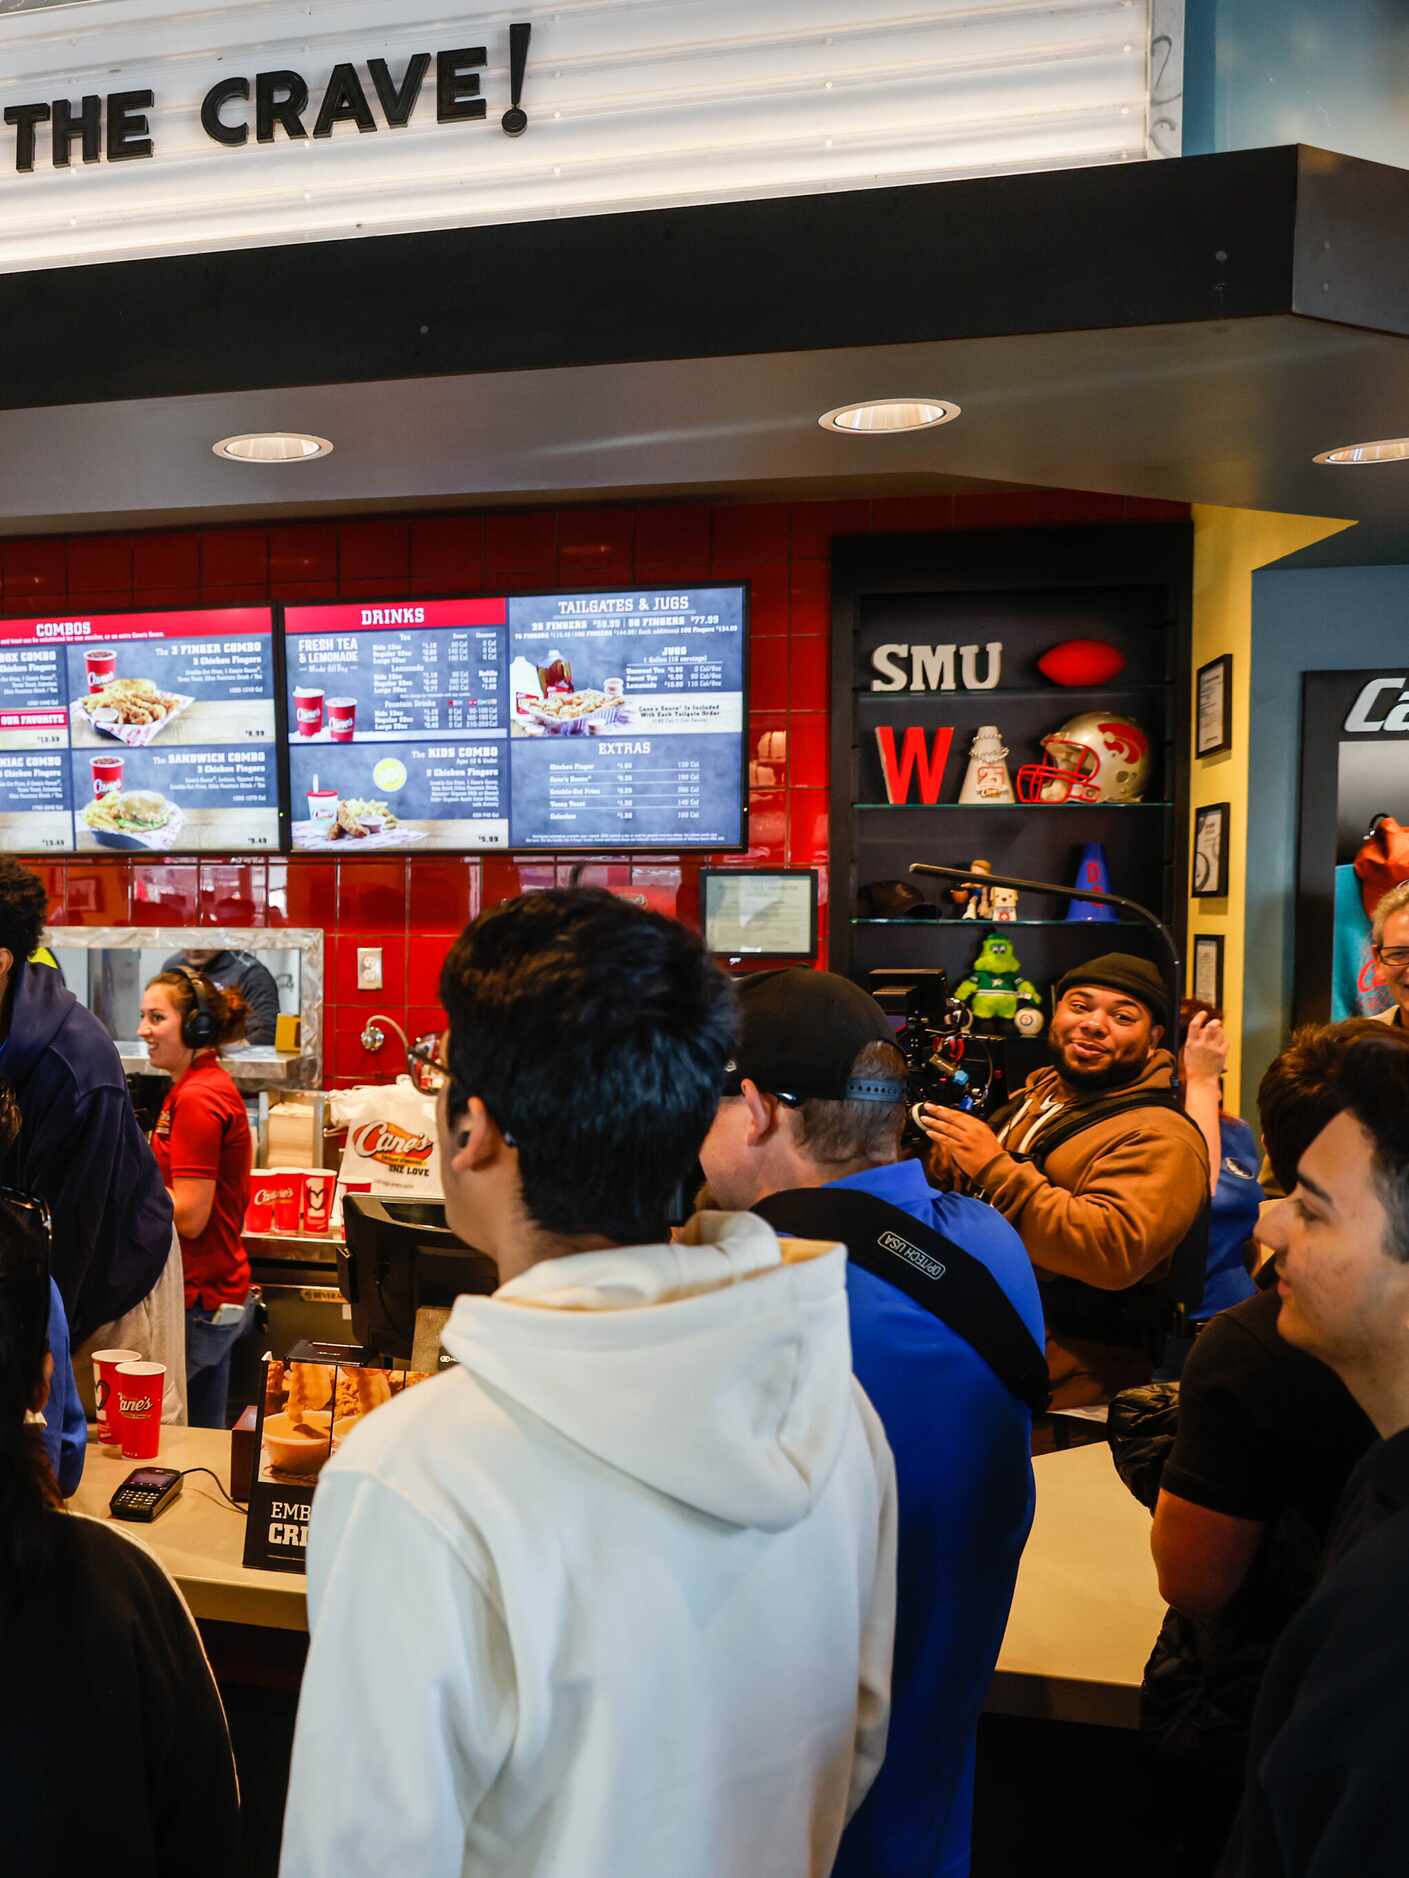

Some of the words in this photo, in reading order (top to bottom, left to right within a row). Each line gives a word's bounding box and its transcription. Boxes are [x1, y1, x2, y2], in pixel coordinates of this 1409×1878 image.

[3, 89, 154, 174] THE
[200, 22, 532, 147] CRAVE!
[558, 599, 633, 615] TAILGATES
[639, 598, 650, 611] &
[653, 596, 689, 611] JUGS
[361, 608, 425, 625] DRINKS
[546, 620, 587, 630] FINGERS
[642, 616, 684, 626] FINGERS
[36, 622, 91, 637] COMBOS
[180, 644, 220, 655] FINGER
[224, 642, 262, 653] COMBO
[298, 639, 334, 652] FRESH
[336, 638, 358, 650] TEA
[662, 646, 687, 656] JUGS
[20, 651, 56, 662] COMBO
[200, 656, 230, 665] Chicken
[232, 656, 262, 664] Fingers
[299, 652, 306, 664] &
[308, 651, 358, 663] LEMONADE
[28, 663, 56, 673] Fingers
[870, 642, 1002, 693] SMU
[0, 715, 20, 725] OUR
[21, 714, 64, 725] FAVORITE
[428, 748, 454, 758] KIDS
[458, 746, 498, 758] COMBO
[598, 742, 651, 755] EXTRAS
[26, 756, 61, 767] COMBO
[168, 753, 225, 764] SANDWICH
[228, 752, 266, 762] COMBO
[204, 765, 234, 774] Chicken
[236, 764, 266, 773] Fingers
[876, 725, 954, 805] W
[34, 768, 62, 777] Fingers
[434, 768, 465, 776] Chicken
[467, 768, 498, 777] Fingers
[355, 1120, 434, 1158] Cane's
[406, 1166, 430, 1177] LOVE
[884, 1234, 907, 1253] USA
[118, 1391, 153, 1412] ane's
